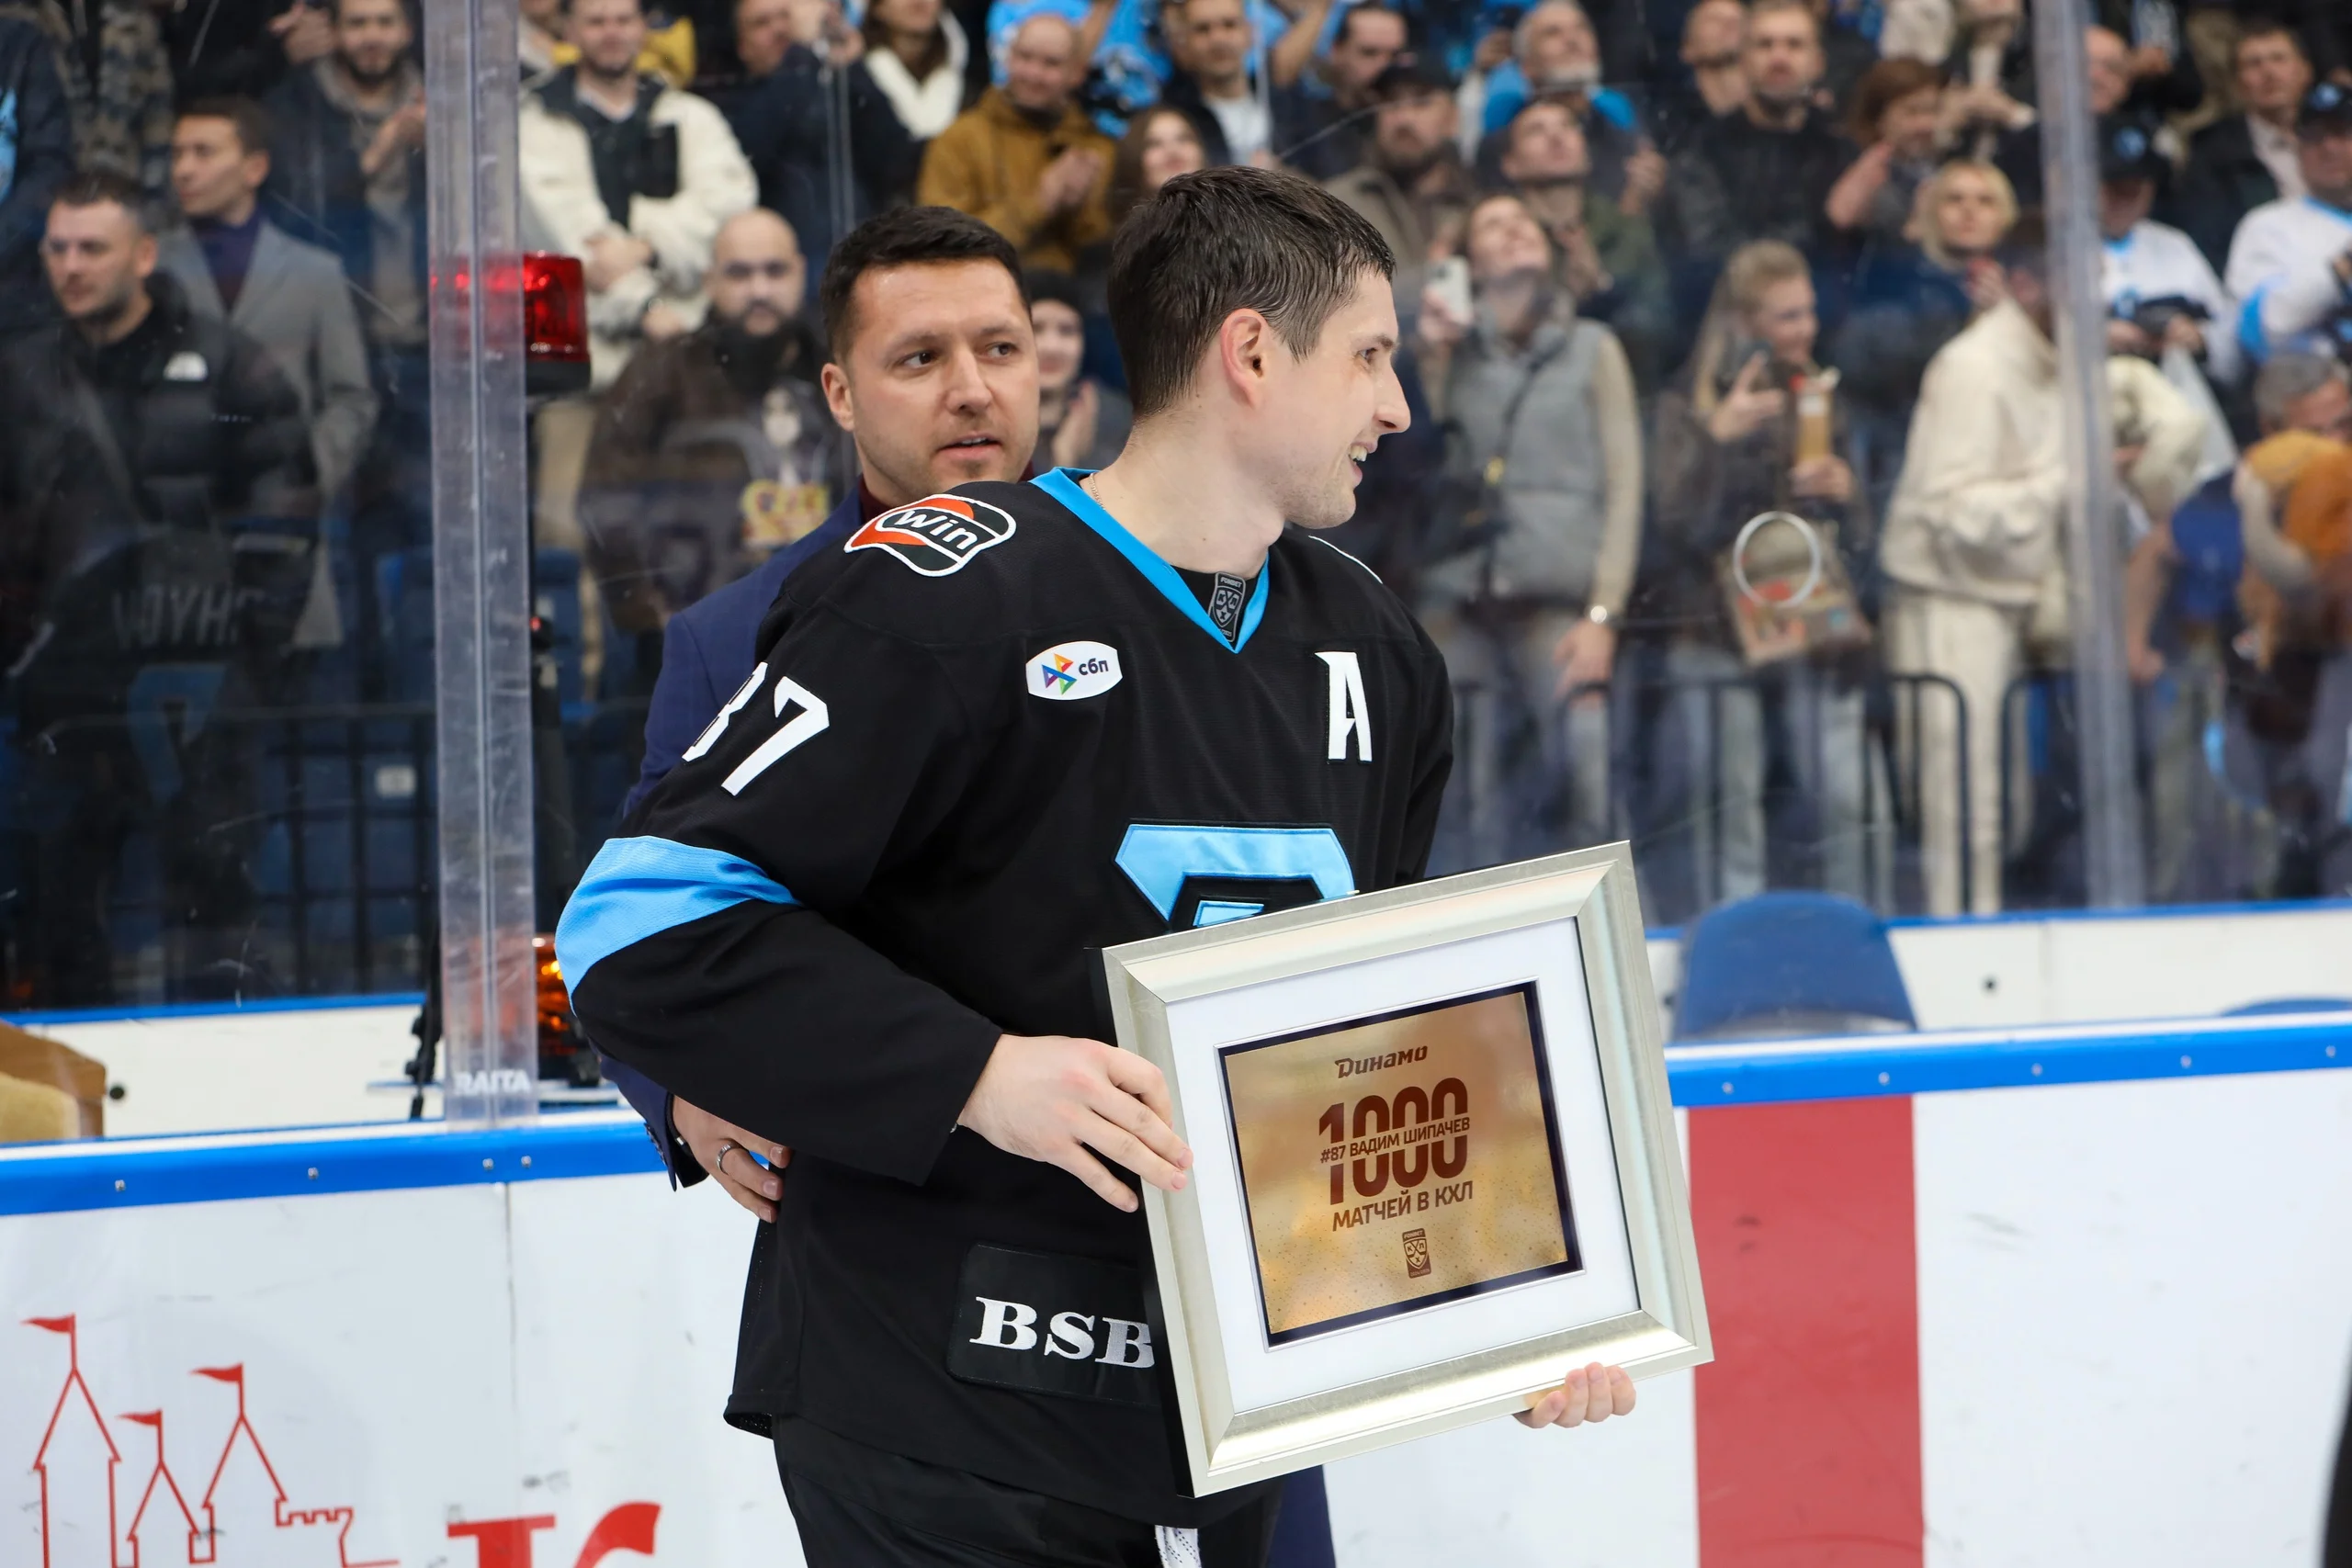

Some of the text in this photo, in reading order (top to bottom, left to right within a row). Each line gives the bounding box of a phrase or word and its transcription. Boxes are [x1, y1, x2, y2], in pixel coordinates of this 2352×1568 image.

[894, 510, 978, 550] win
[1078, 658, 1109, 676] сбп
[1314, 650, 1373, 762] A
[454, 1069, 532, 1097] RAITA
[1318, 1077, 1468, 1205] 1000
[1320, 1116, 1470, 1164] #87 ВАДИМ ШИПАЧЕВ
[1332, 1180, 1473, 1232] МАТЧЕЙ В КХЛ
[969, 1296, 1155, 1369] BSB
